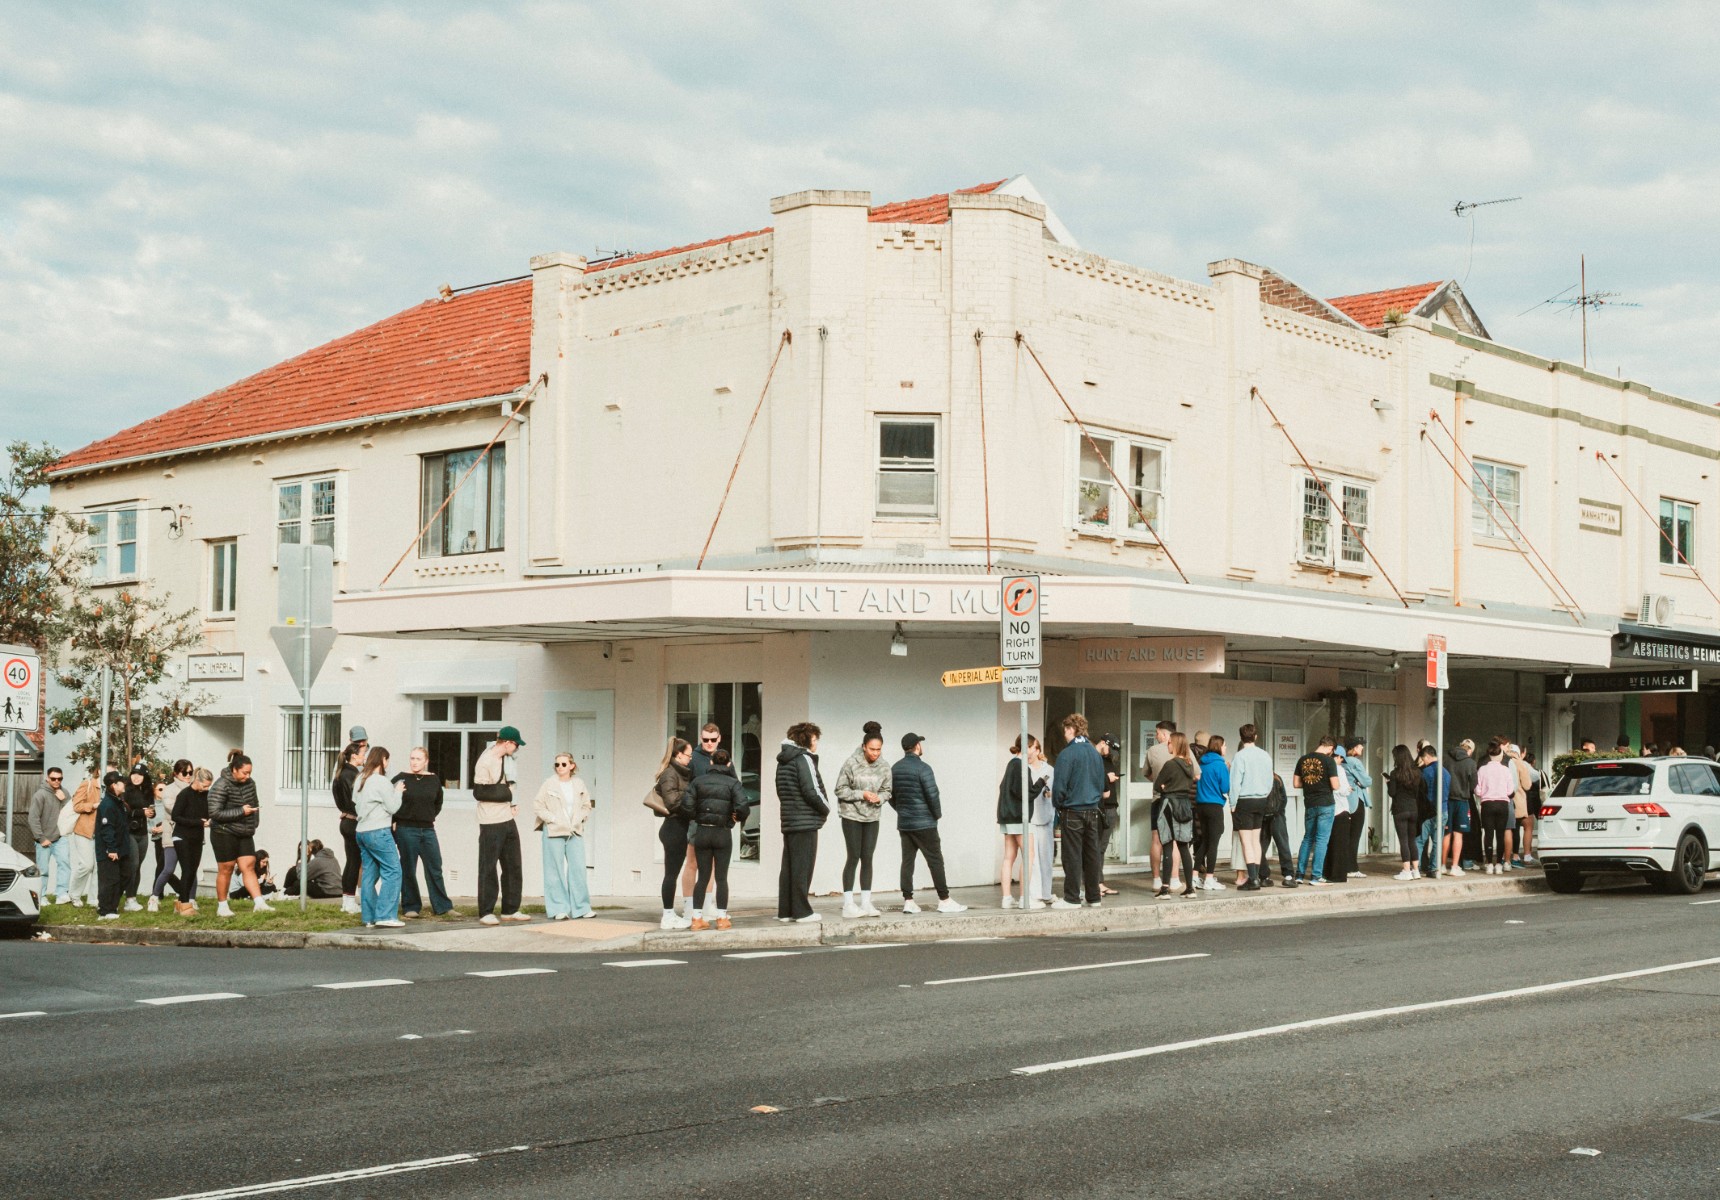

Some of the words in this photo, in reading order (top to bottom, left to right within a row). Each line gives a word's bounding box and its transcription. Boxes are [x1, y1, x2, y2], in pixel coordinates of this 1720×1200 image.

[1581, 509, 1616, 524] MANHATTAN
[745, 585, 848, 612] HUNT
[859, 587, 931, 613] AND
[950, 589, 1049, 615] MUE
[1009, 621, 1031, 635] NO
[1005, 638, 1036, 648] RIGHT
[1007, 651, 1034, 661] TURN
[1085, 648, 1122, 662] HUNT
[1127, 648, 1156, 662] AND
[1162, 647, 1206, 662] MUSE
[1632, 642, 1690, 659] AESTHETICS
[8, 667, 27, 681] 40
[985, 668, 999, 681] AVE
[1004, 675, 1038, 684] NOON-7PM
[1640, 675, 1685, 686] EIMEAR
[1008, 686, 1036, 695] SAT-SUN
